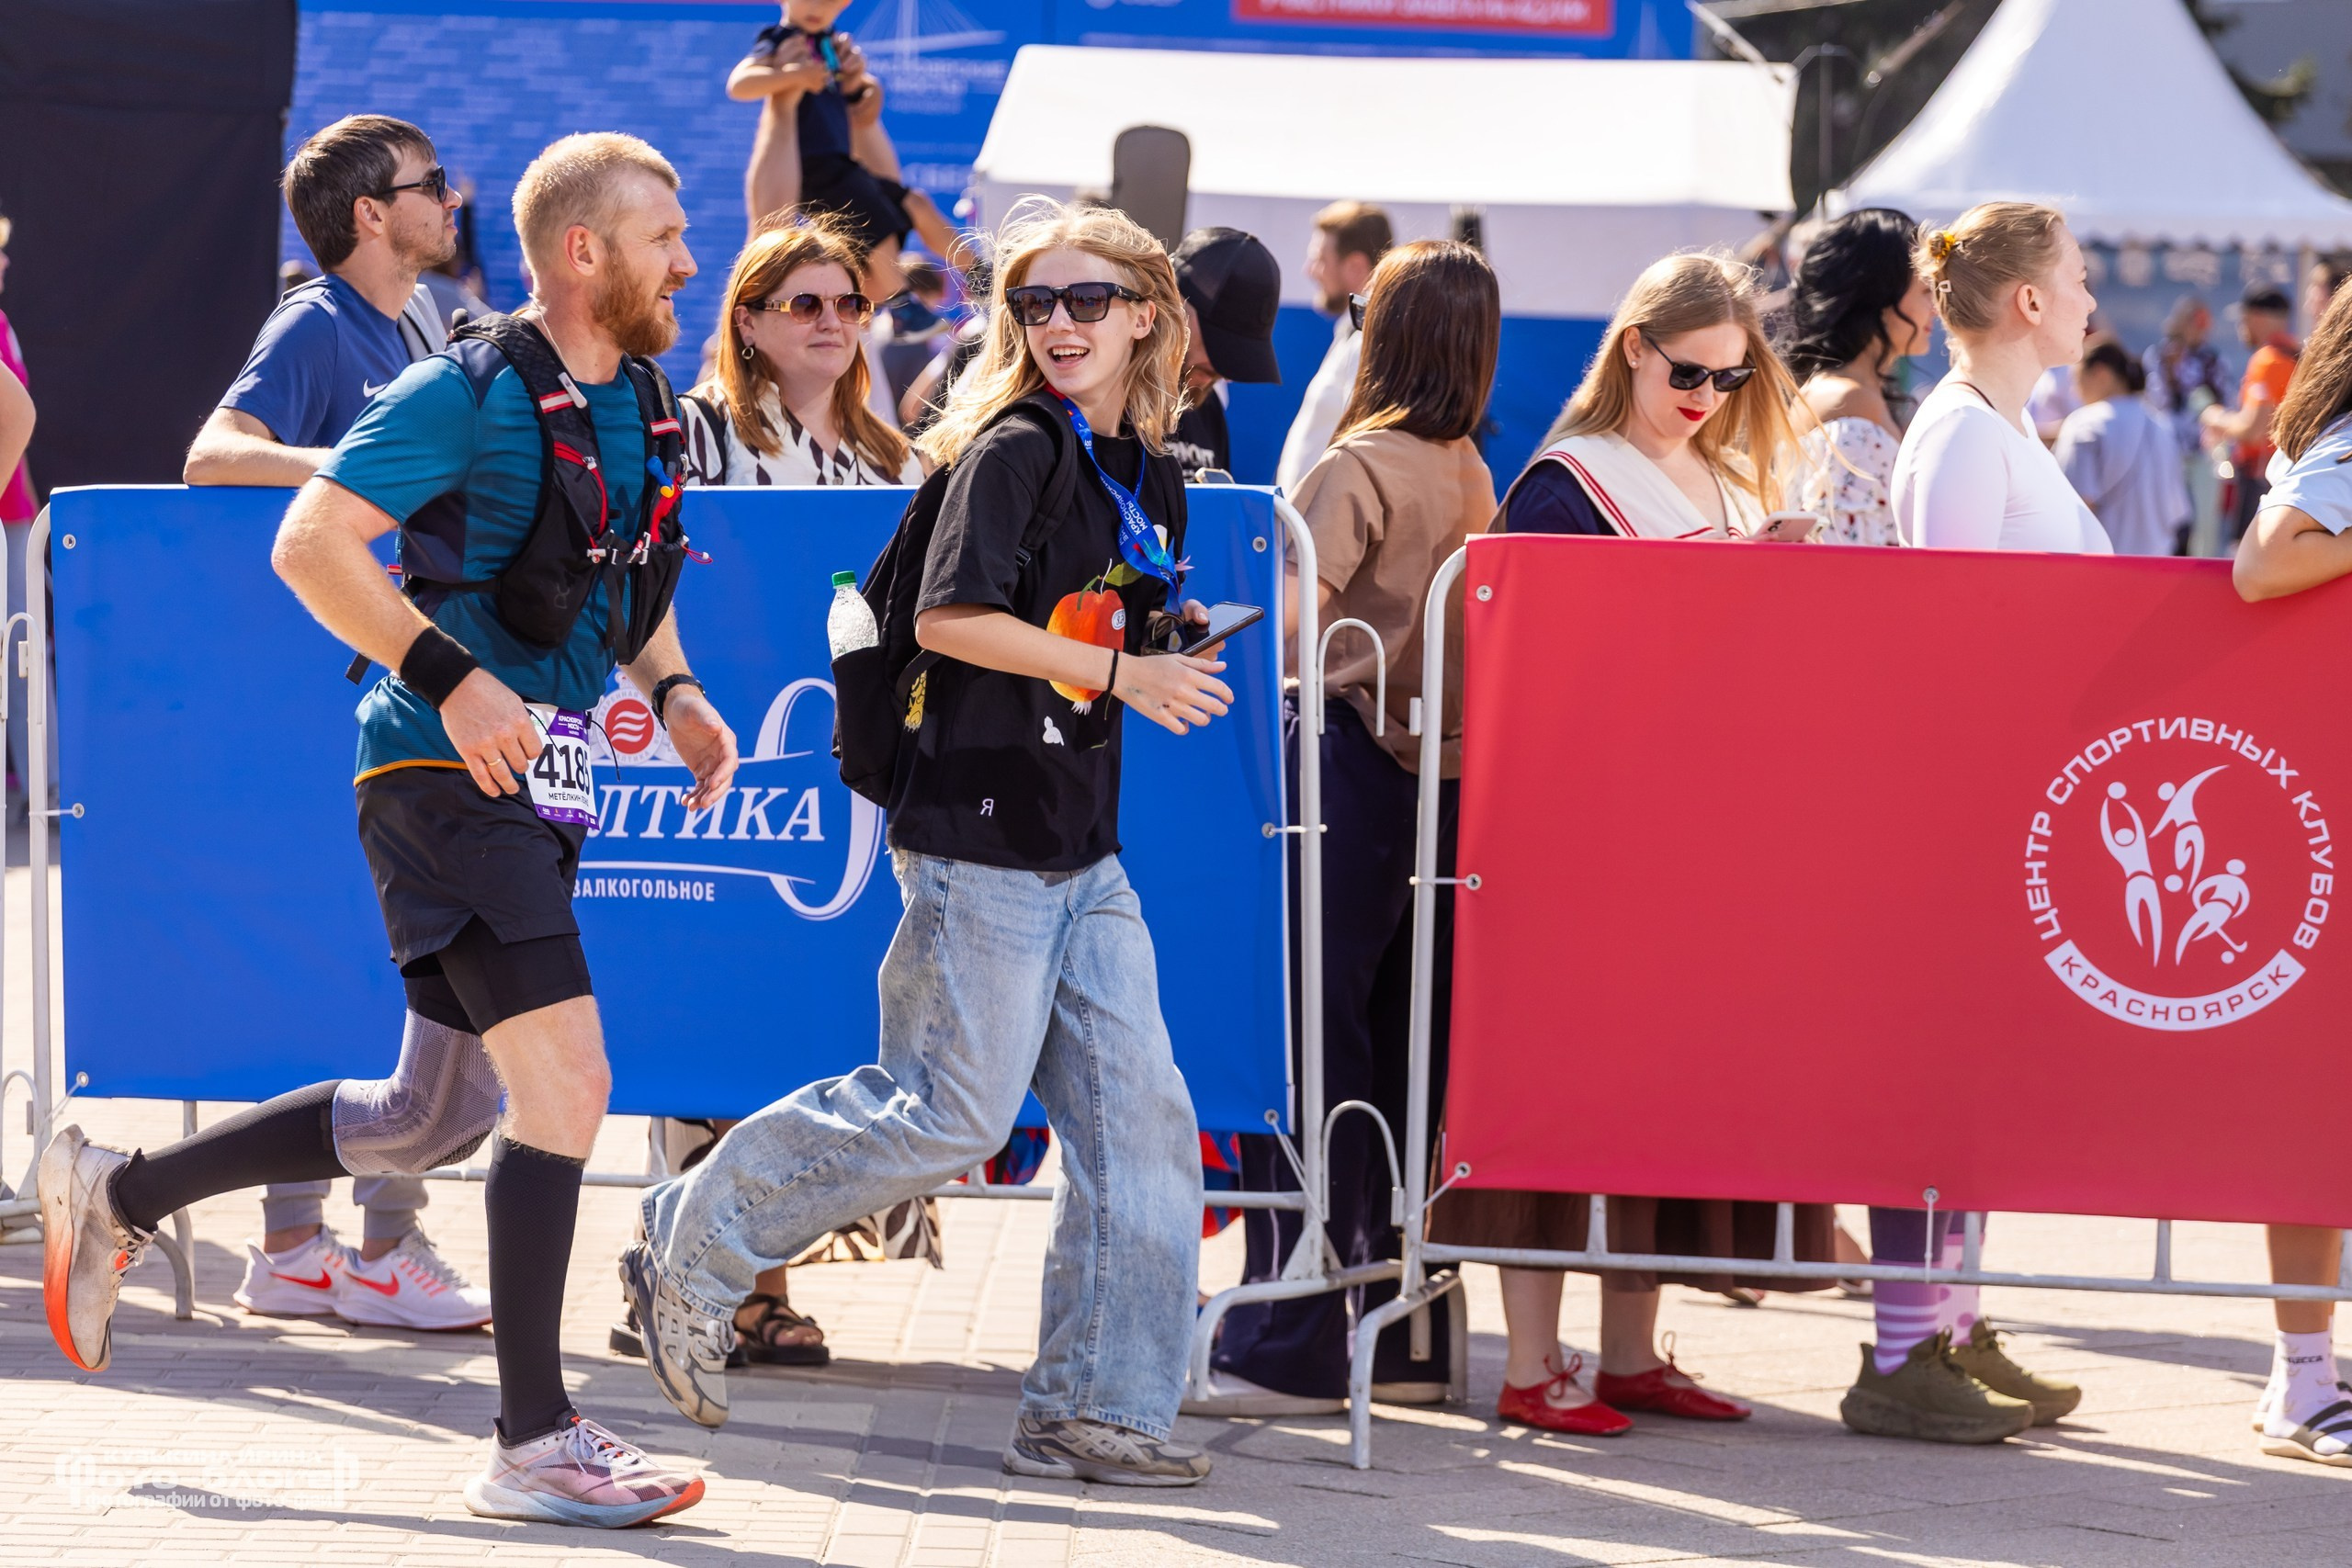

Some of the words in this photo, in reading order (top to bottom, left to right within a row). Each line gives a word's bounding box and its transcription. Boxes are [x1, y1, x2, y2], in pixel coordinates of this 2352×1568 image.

[1126, 501, 1148, 531] МОСТЫ
[586, 784, 825, 841] ЛТИКА
[2024, 810, 2062, 941] ЦЕНТР
[2045, 716, 2300, 806] СПОРТИВНЫХ
[2291, 790, 2335, 950] КЛУБОВ
[572, 877, 716, 902] ЗАЛКОГОЛЬНОЕ
[2059, 954, 2291, 1022] КРАСНОЯРСК
